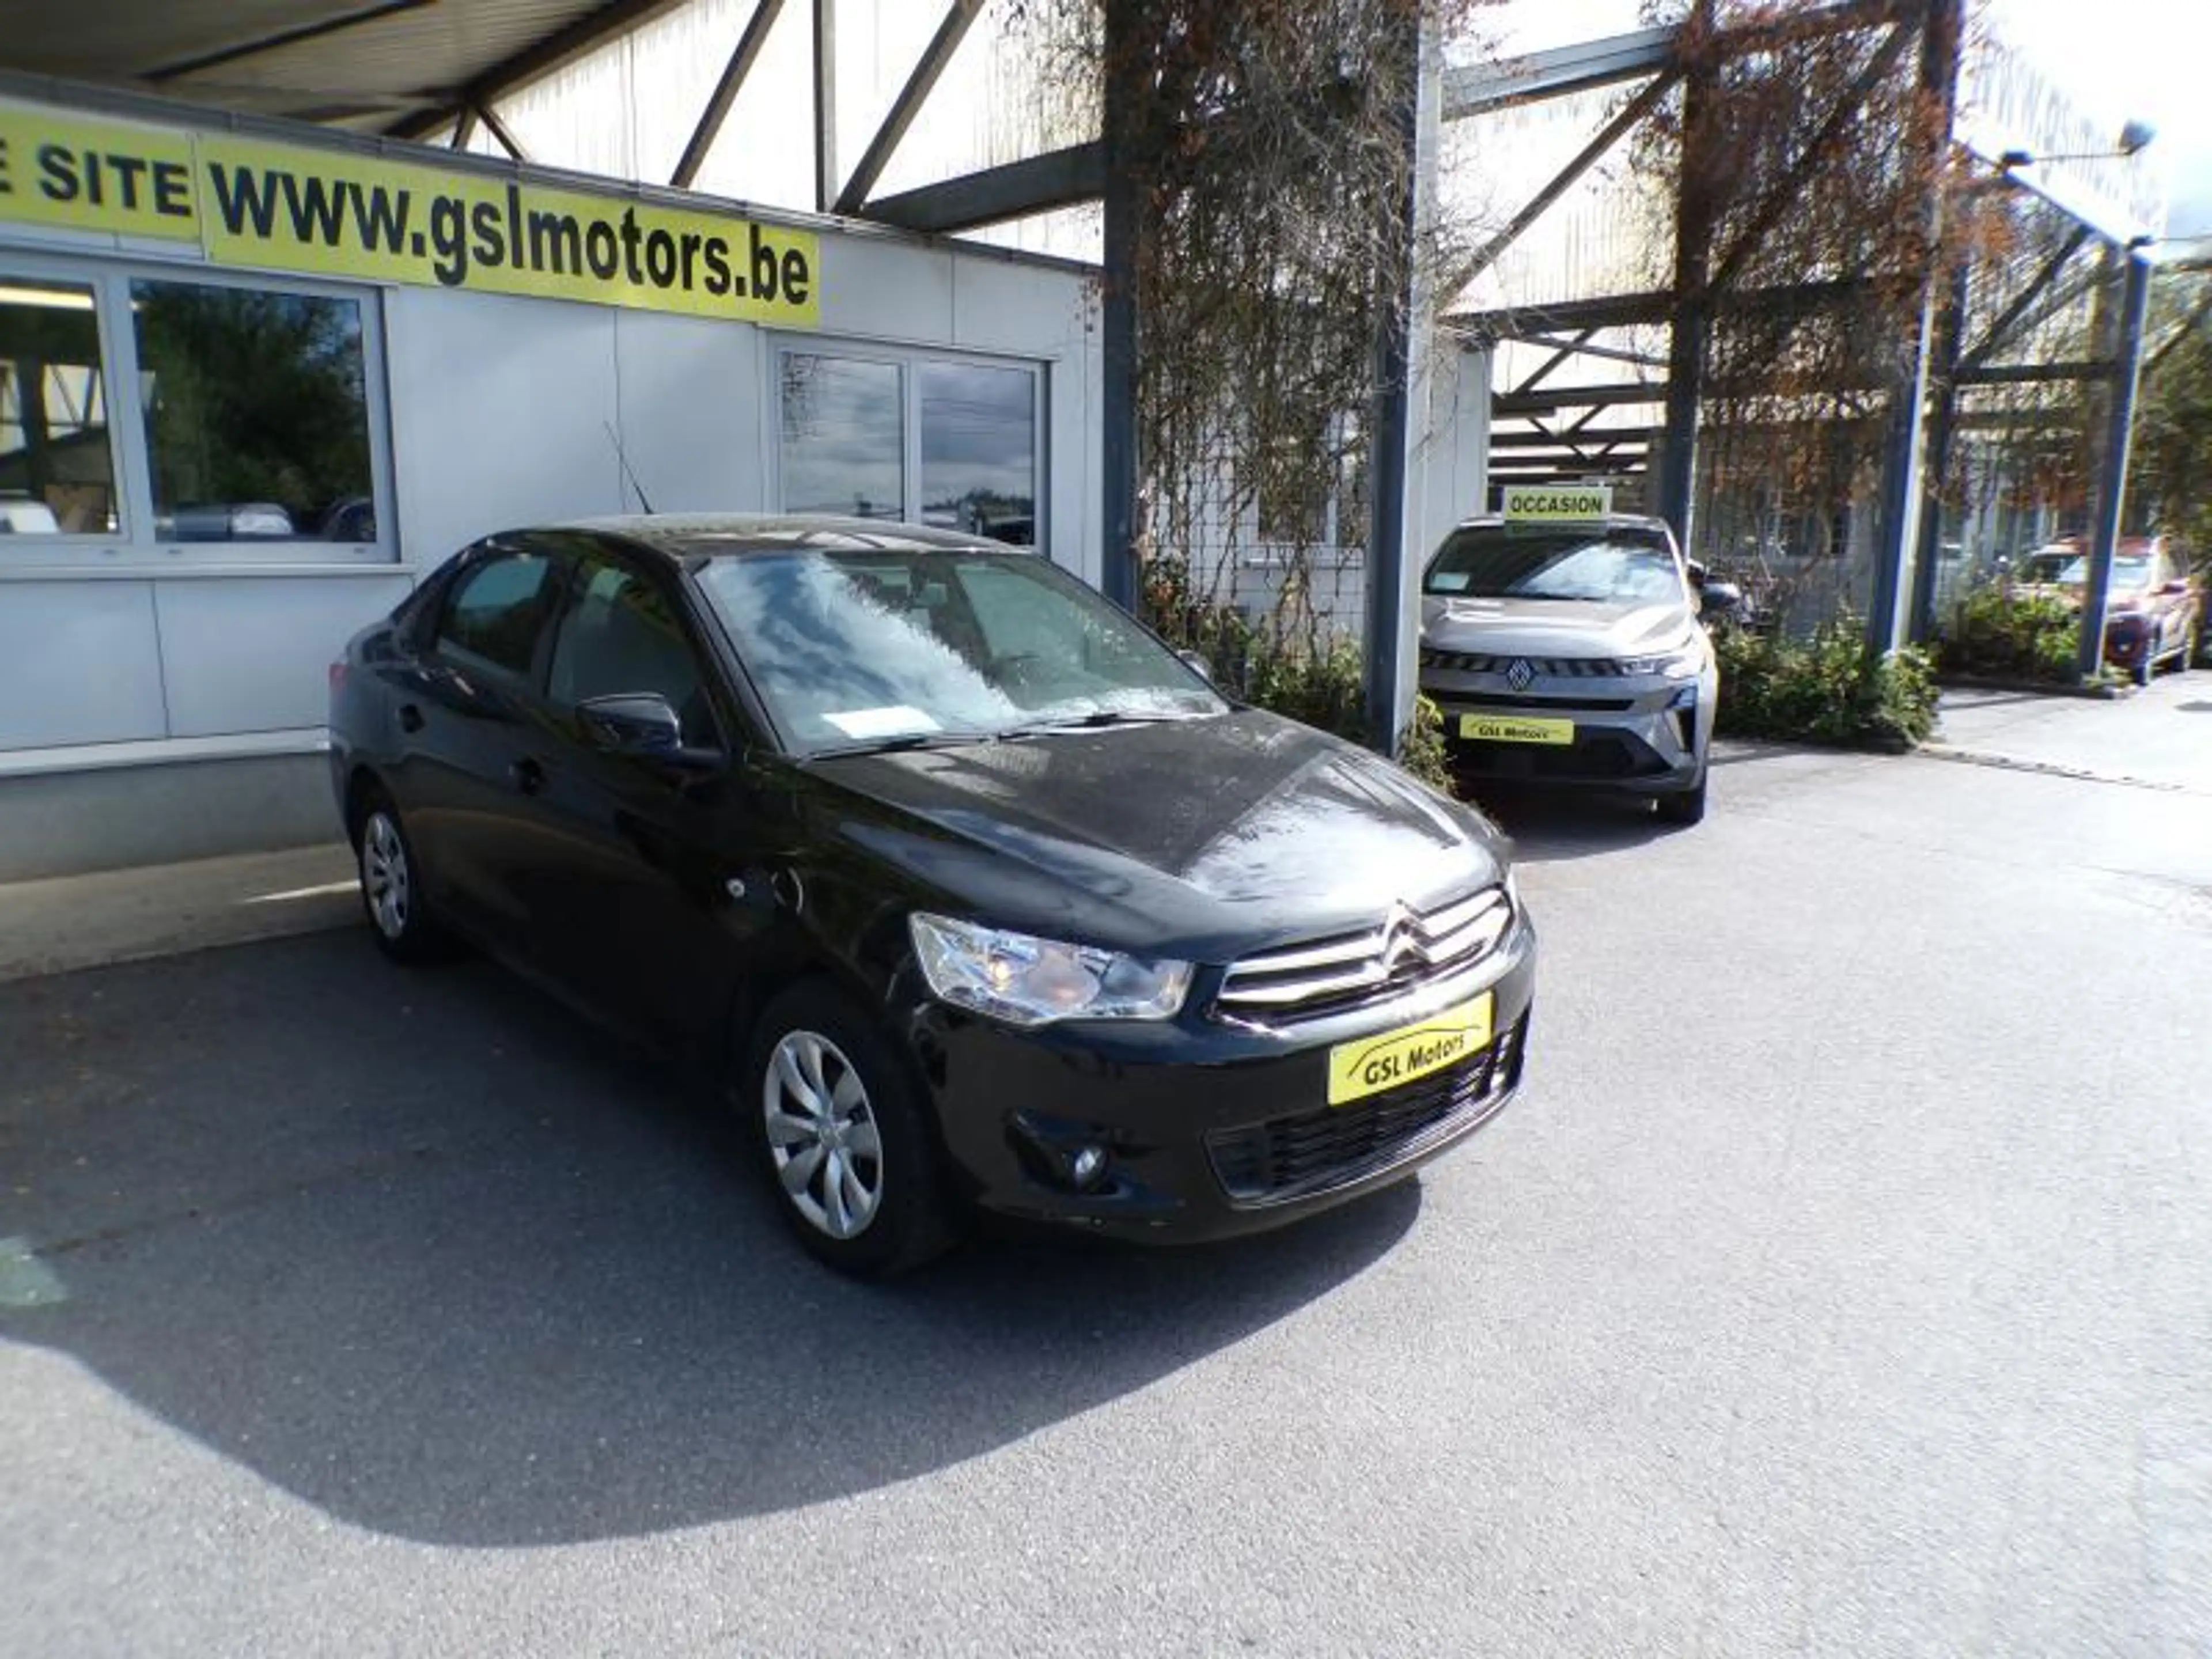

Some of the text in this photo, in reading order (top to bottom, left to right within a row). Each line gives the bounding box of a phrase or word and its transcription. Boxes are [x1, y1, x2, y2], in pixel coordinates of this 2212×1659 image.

[37, 143, 192, 217] SITE
[209, 162, 809, 305] www.gslmotors.be
[1511, 494, 1603, 513] OCCASION
[1364, 1034, 1464, 1085] GSL Motors
